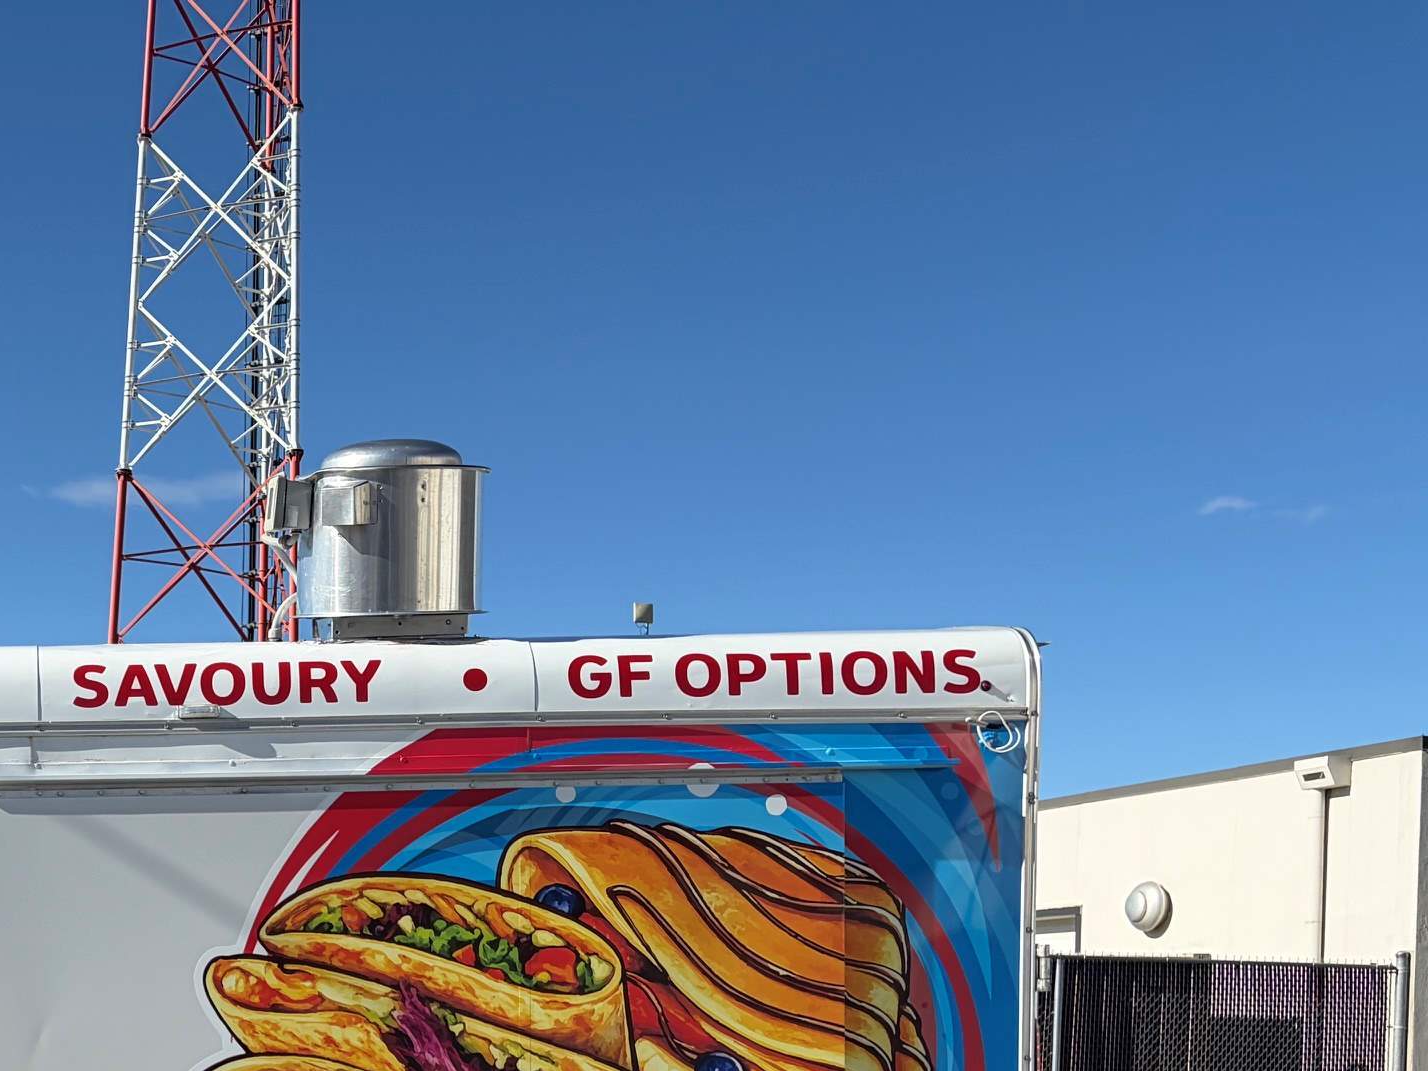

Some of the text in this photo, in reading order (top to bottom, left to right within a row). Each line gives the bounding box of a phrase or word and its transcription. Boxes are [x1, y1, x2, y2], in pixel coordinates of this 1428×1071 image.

[73, 659, 382, 708] SAVOURY
[568, 649, 981, 699] GF OPTIONS
